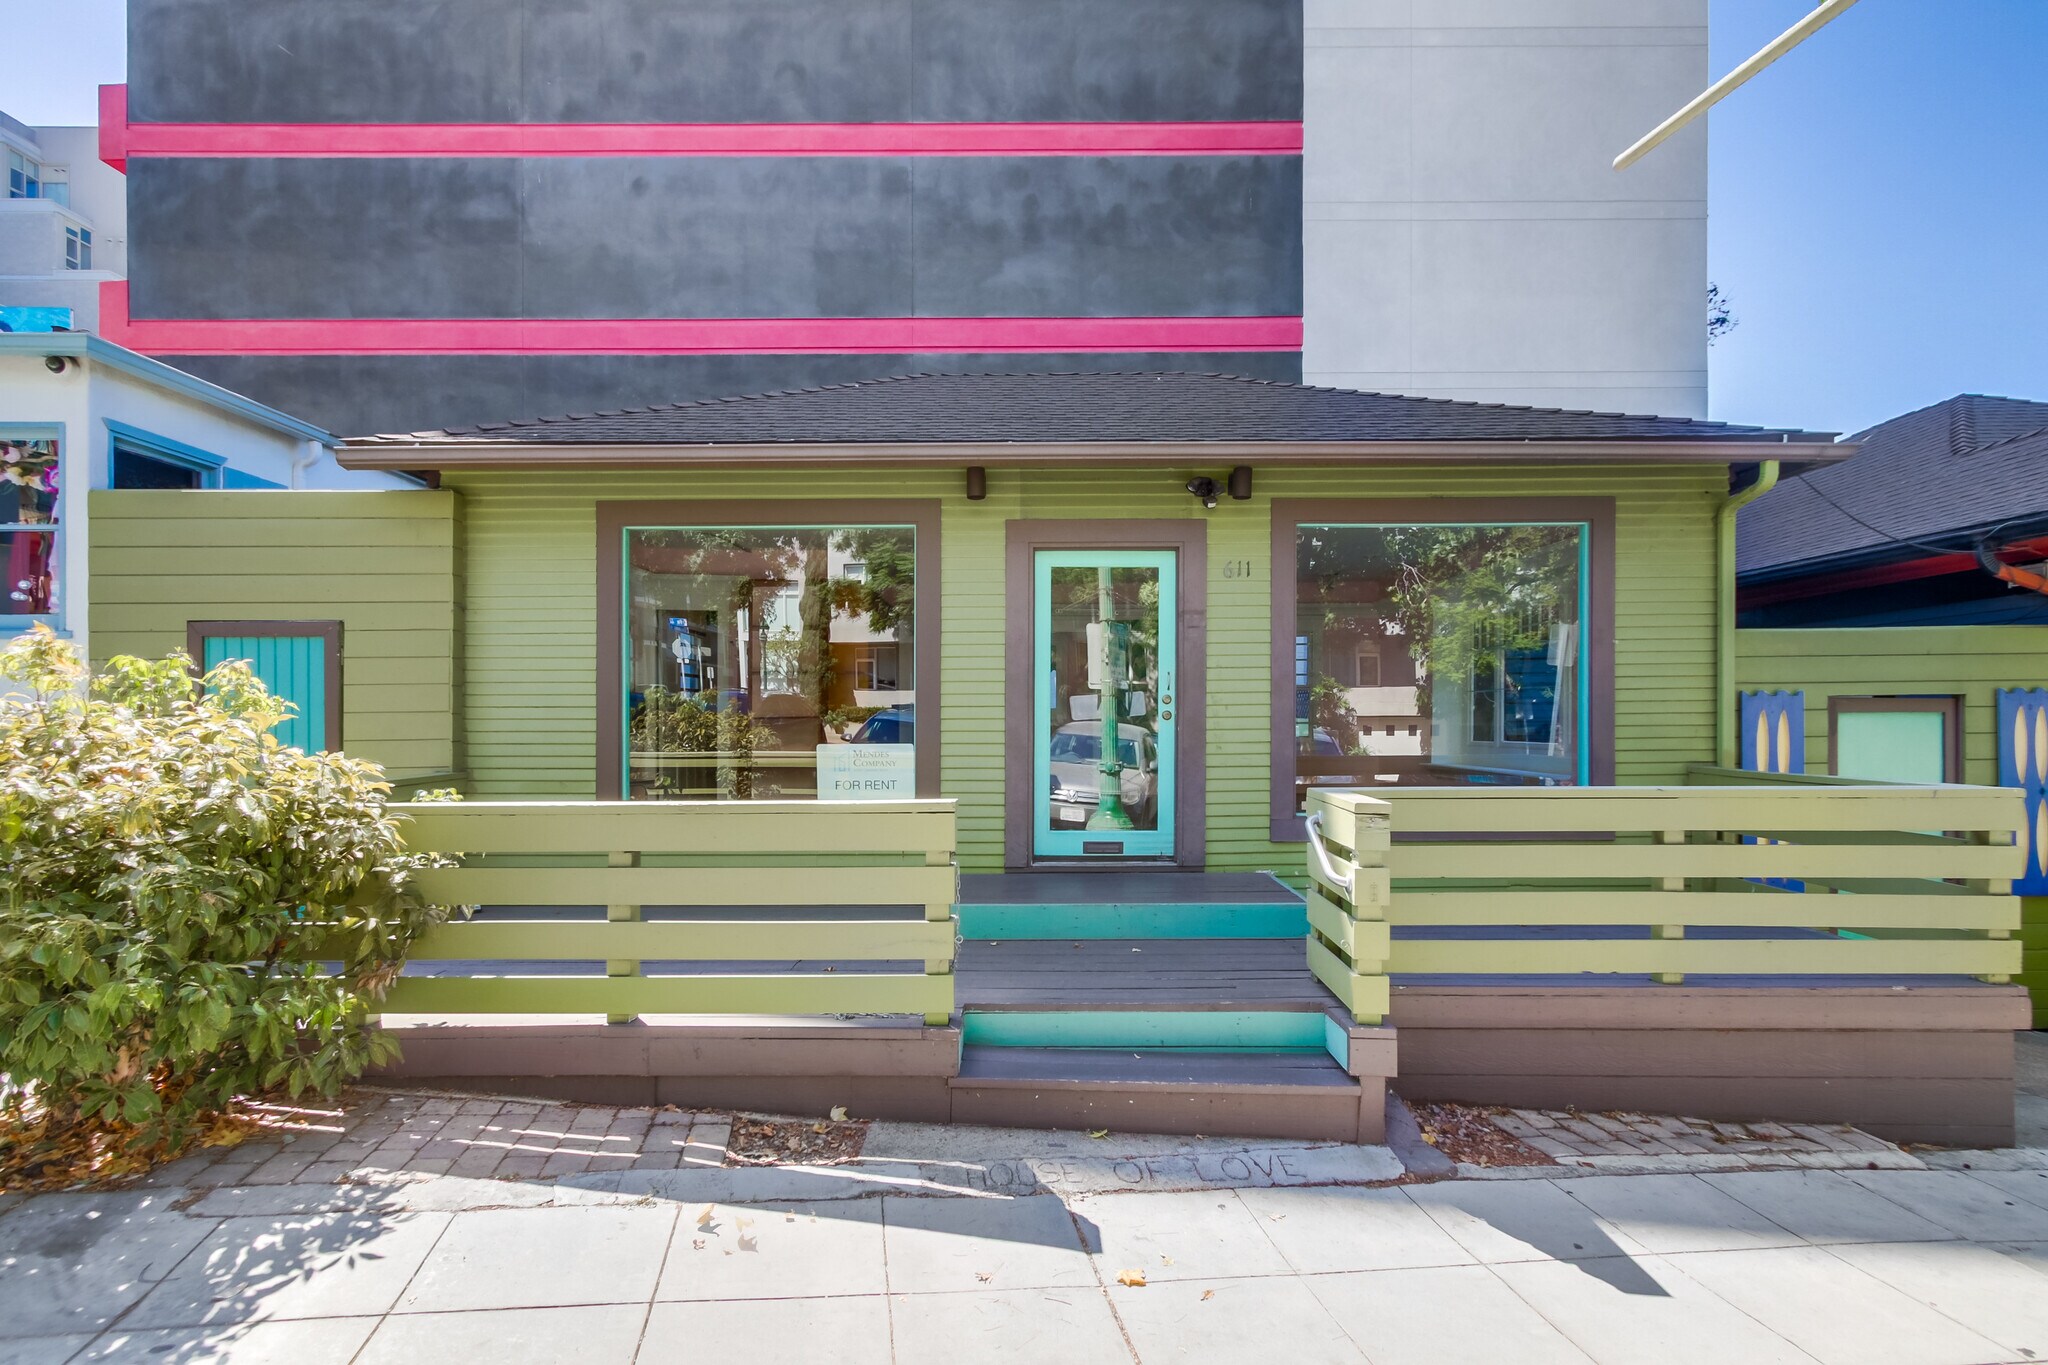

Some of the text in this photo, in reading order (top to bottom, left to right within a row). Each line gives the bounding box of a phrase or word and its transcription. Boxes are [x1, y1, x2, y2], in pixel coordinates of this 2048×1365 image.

[1223, 560, 1250, 578] 611
[853, 759, 896, 767] COMPANY
[835, 780, 897, 790] FOR RENT
[966, 1155, 1307, 1187] HOUSE OF LOVE
